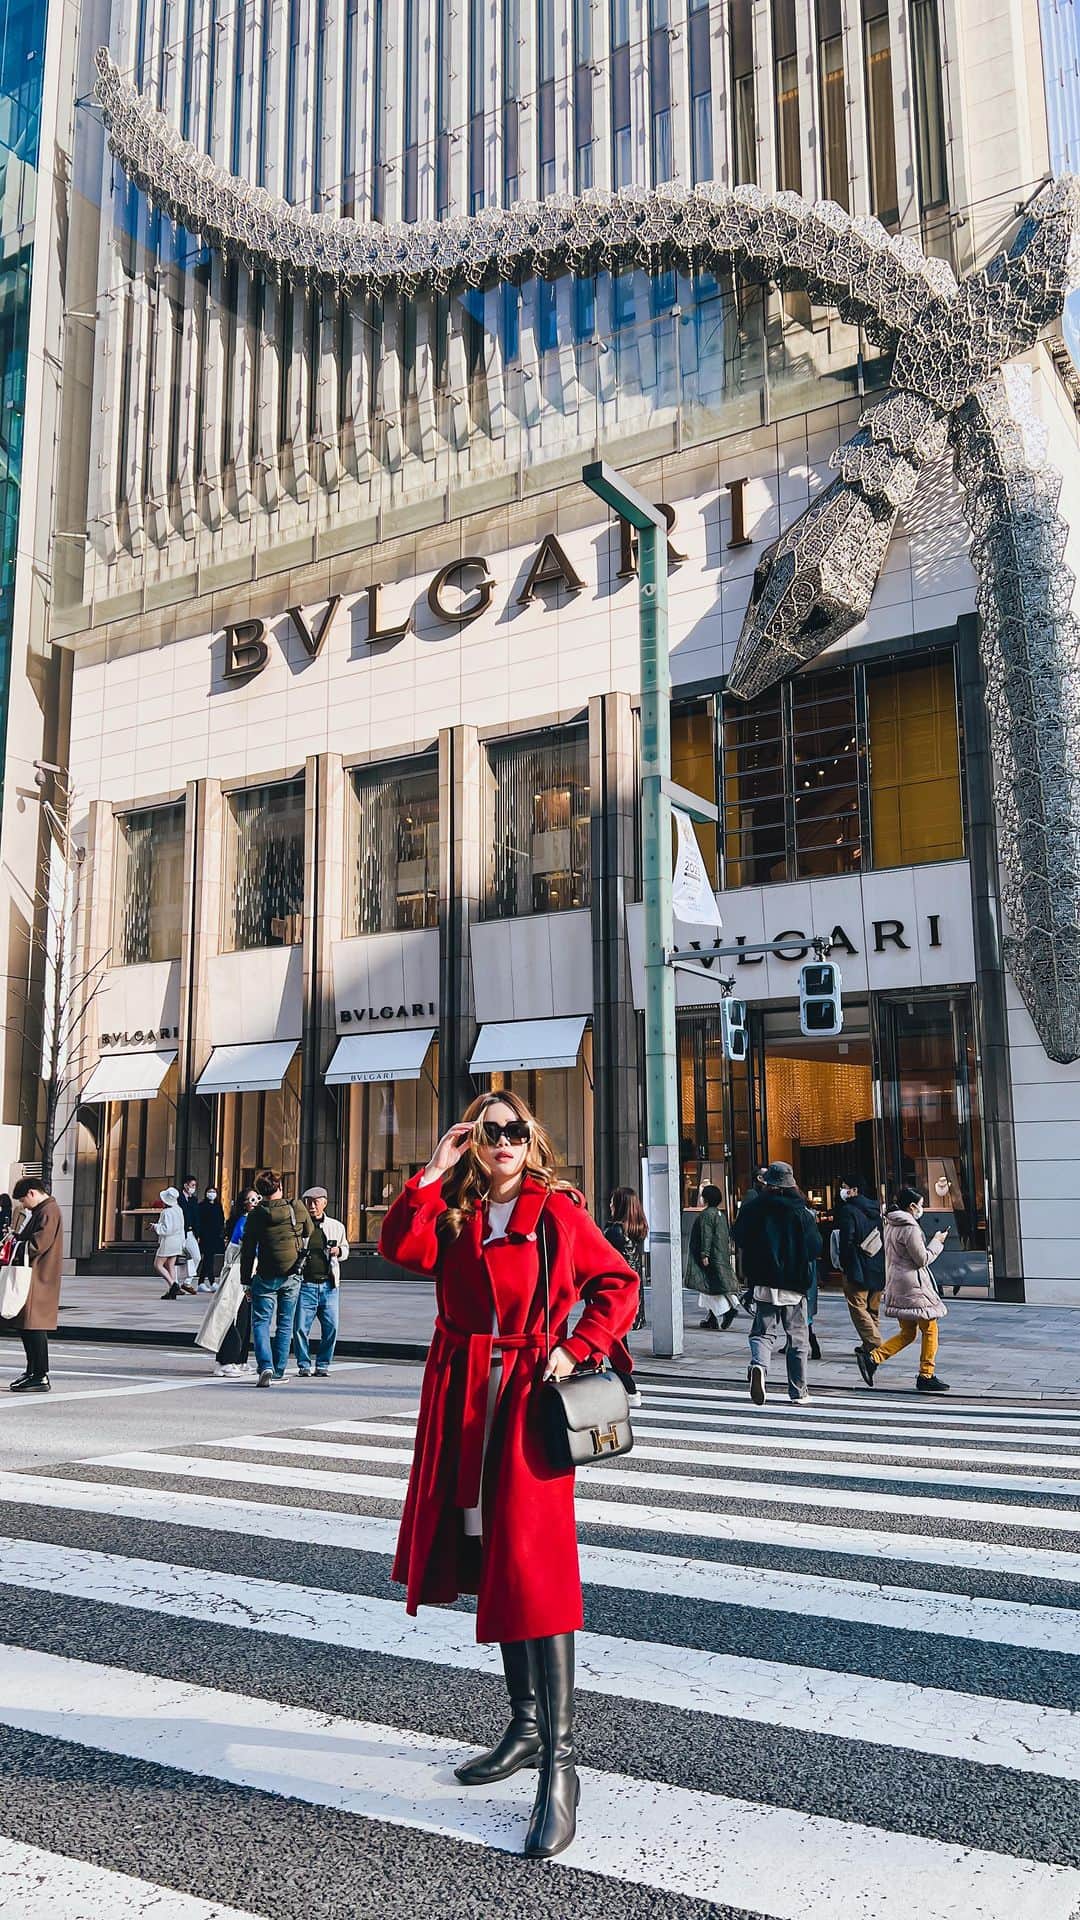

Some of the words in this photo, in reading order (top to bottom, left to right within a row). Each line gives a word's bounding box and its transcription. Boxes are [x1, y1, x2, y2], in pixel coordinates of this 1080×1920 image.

[222, 477, 753, 680] BVLGARI
[673, 914, 942, 969] VLGARI
[340, 1002, 434, 1023] BVLGARI
[102, 1027, 179, 1044] BVLGARI
[350, 1072, 394, 1081] BVLGARI
